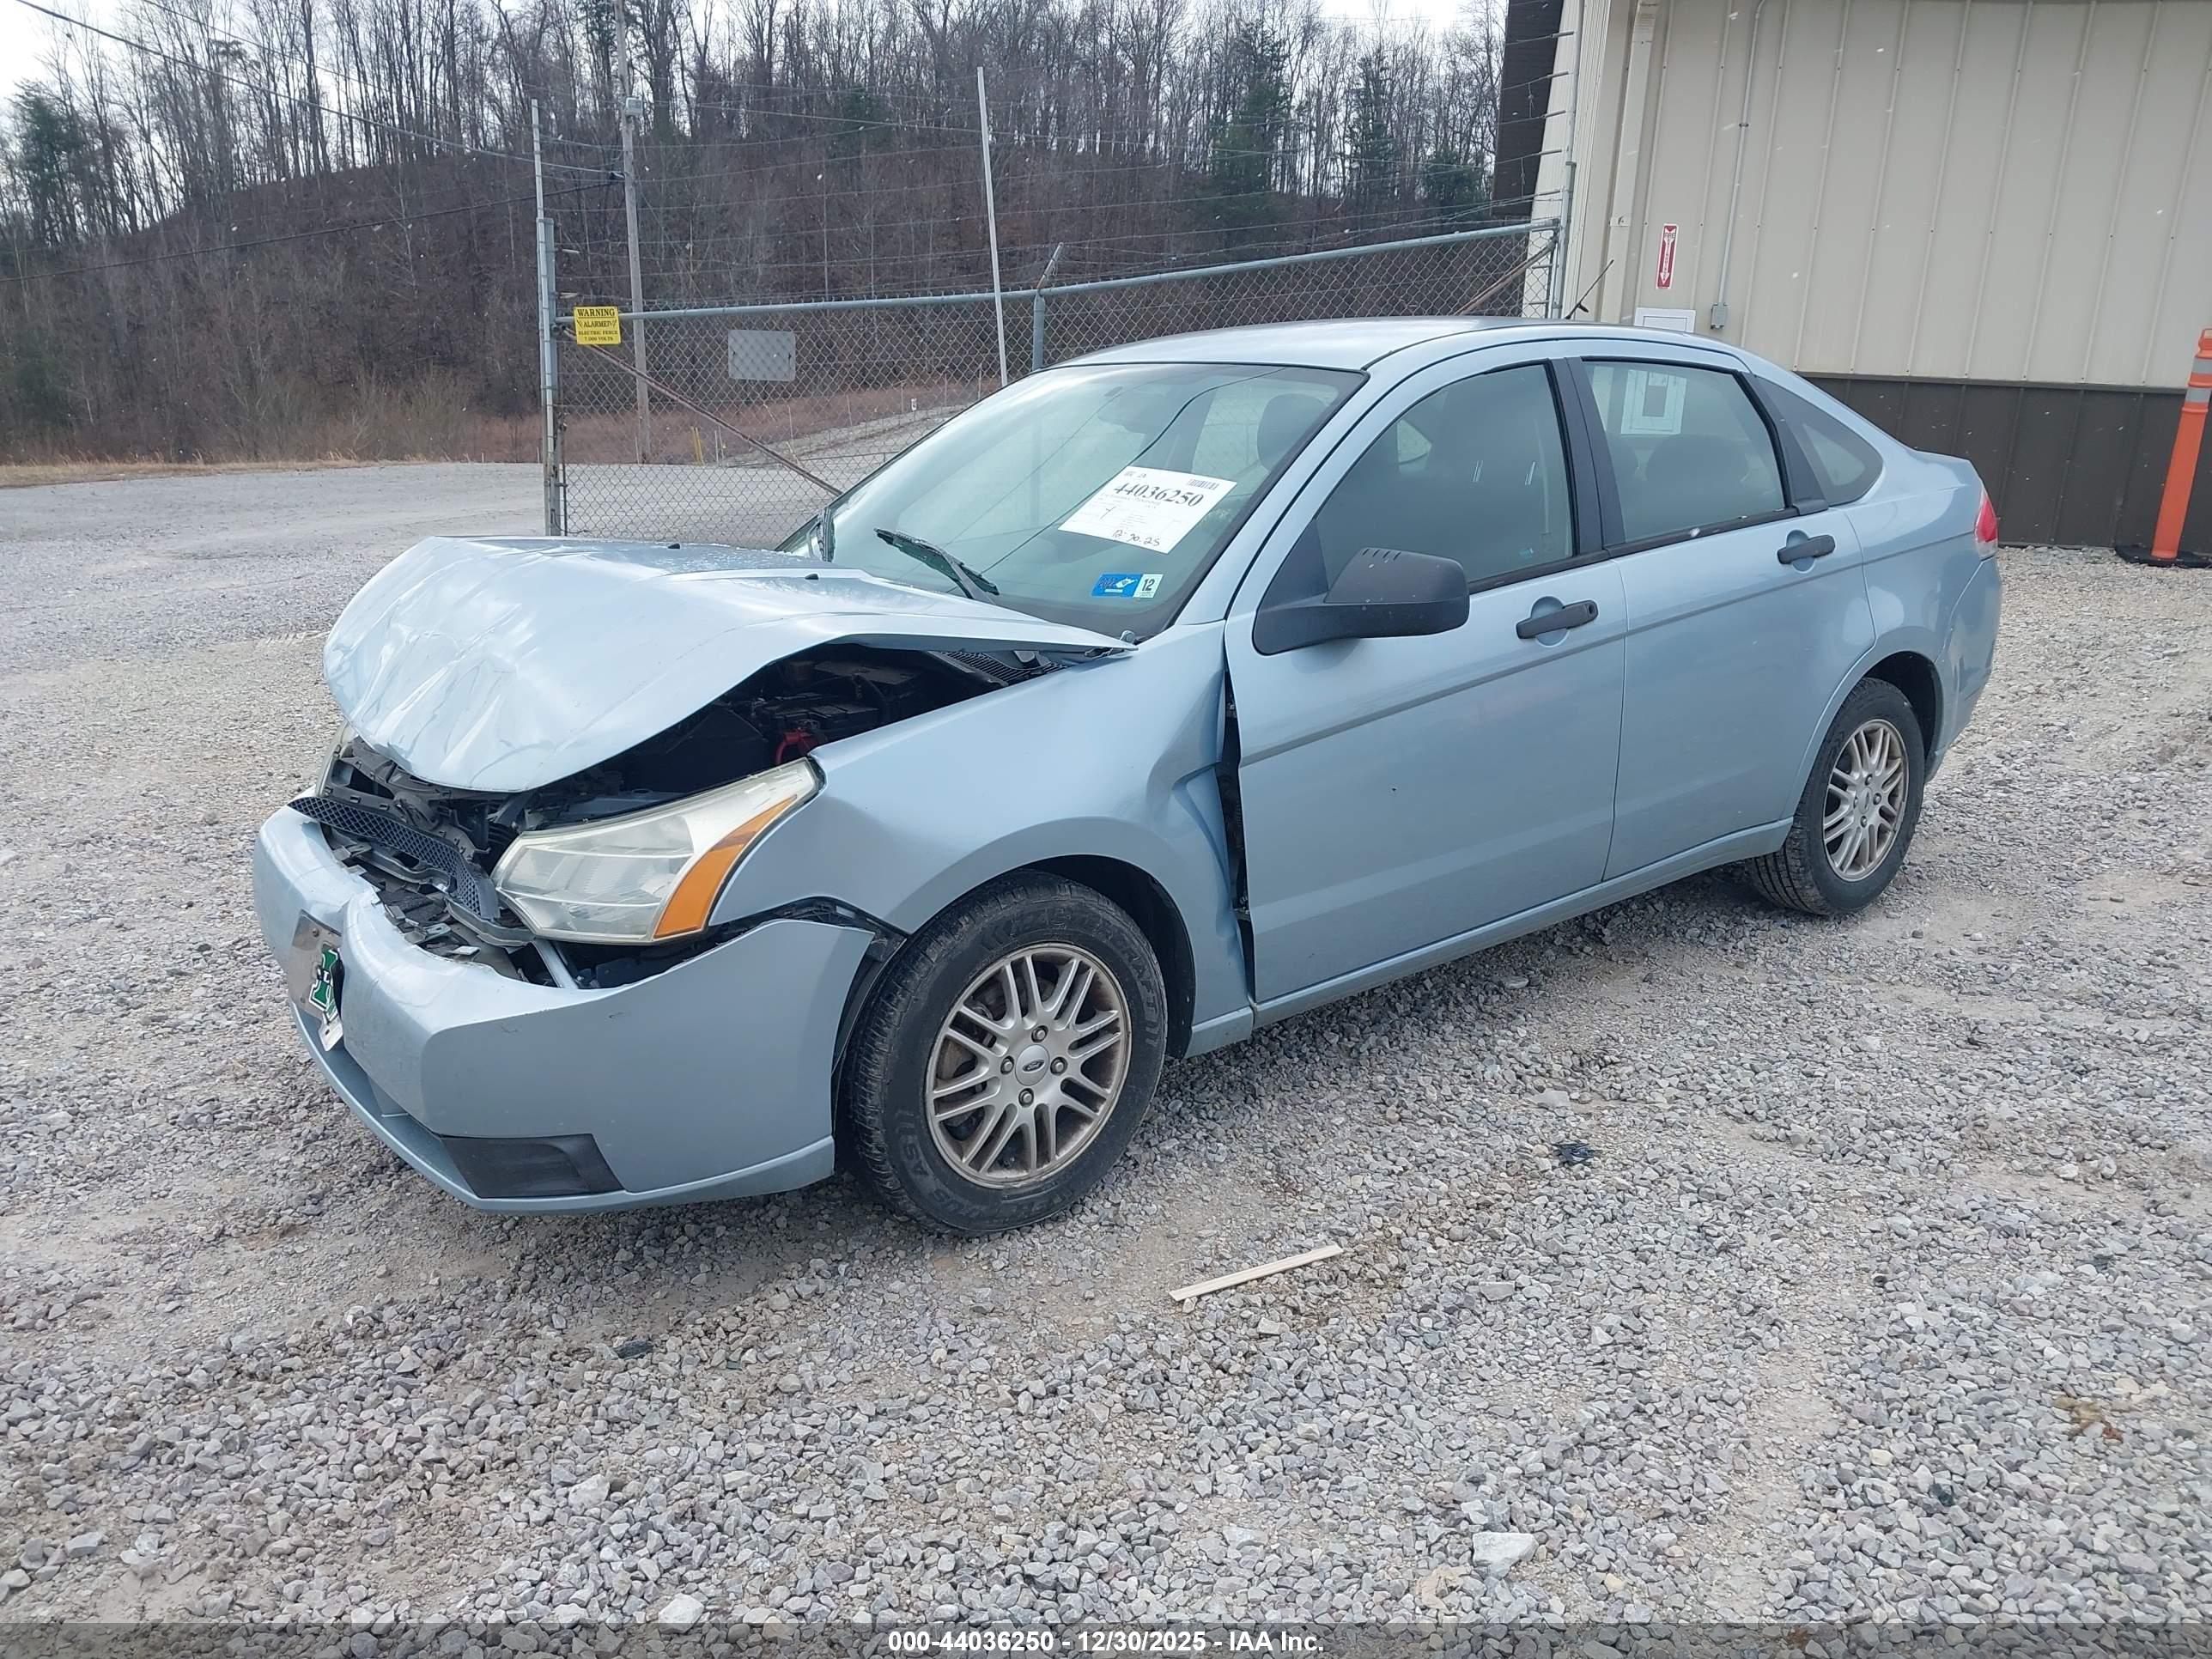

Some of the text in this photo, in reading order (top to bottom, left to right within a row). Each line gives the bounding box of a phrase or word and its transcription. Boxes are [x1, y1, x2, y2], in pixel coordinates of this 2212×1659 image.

[577, 308, 615, 317] WARNING
[1113, 482, 1205, 507] 44036250
[1141, 578, 1156, 592] 12
